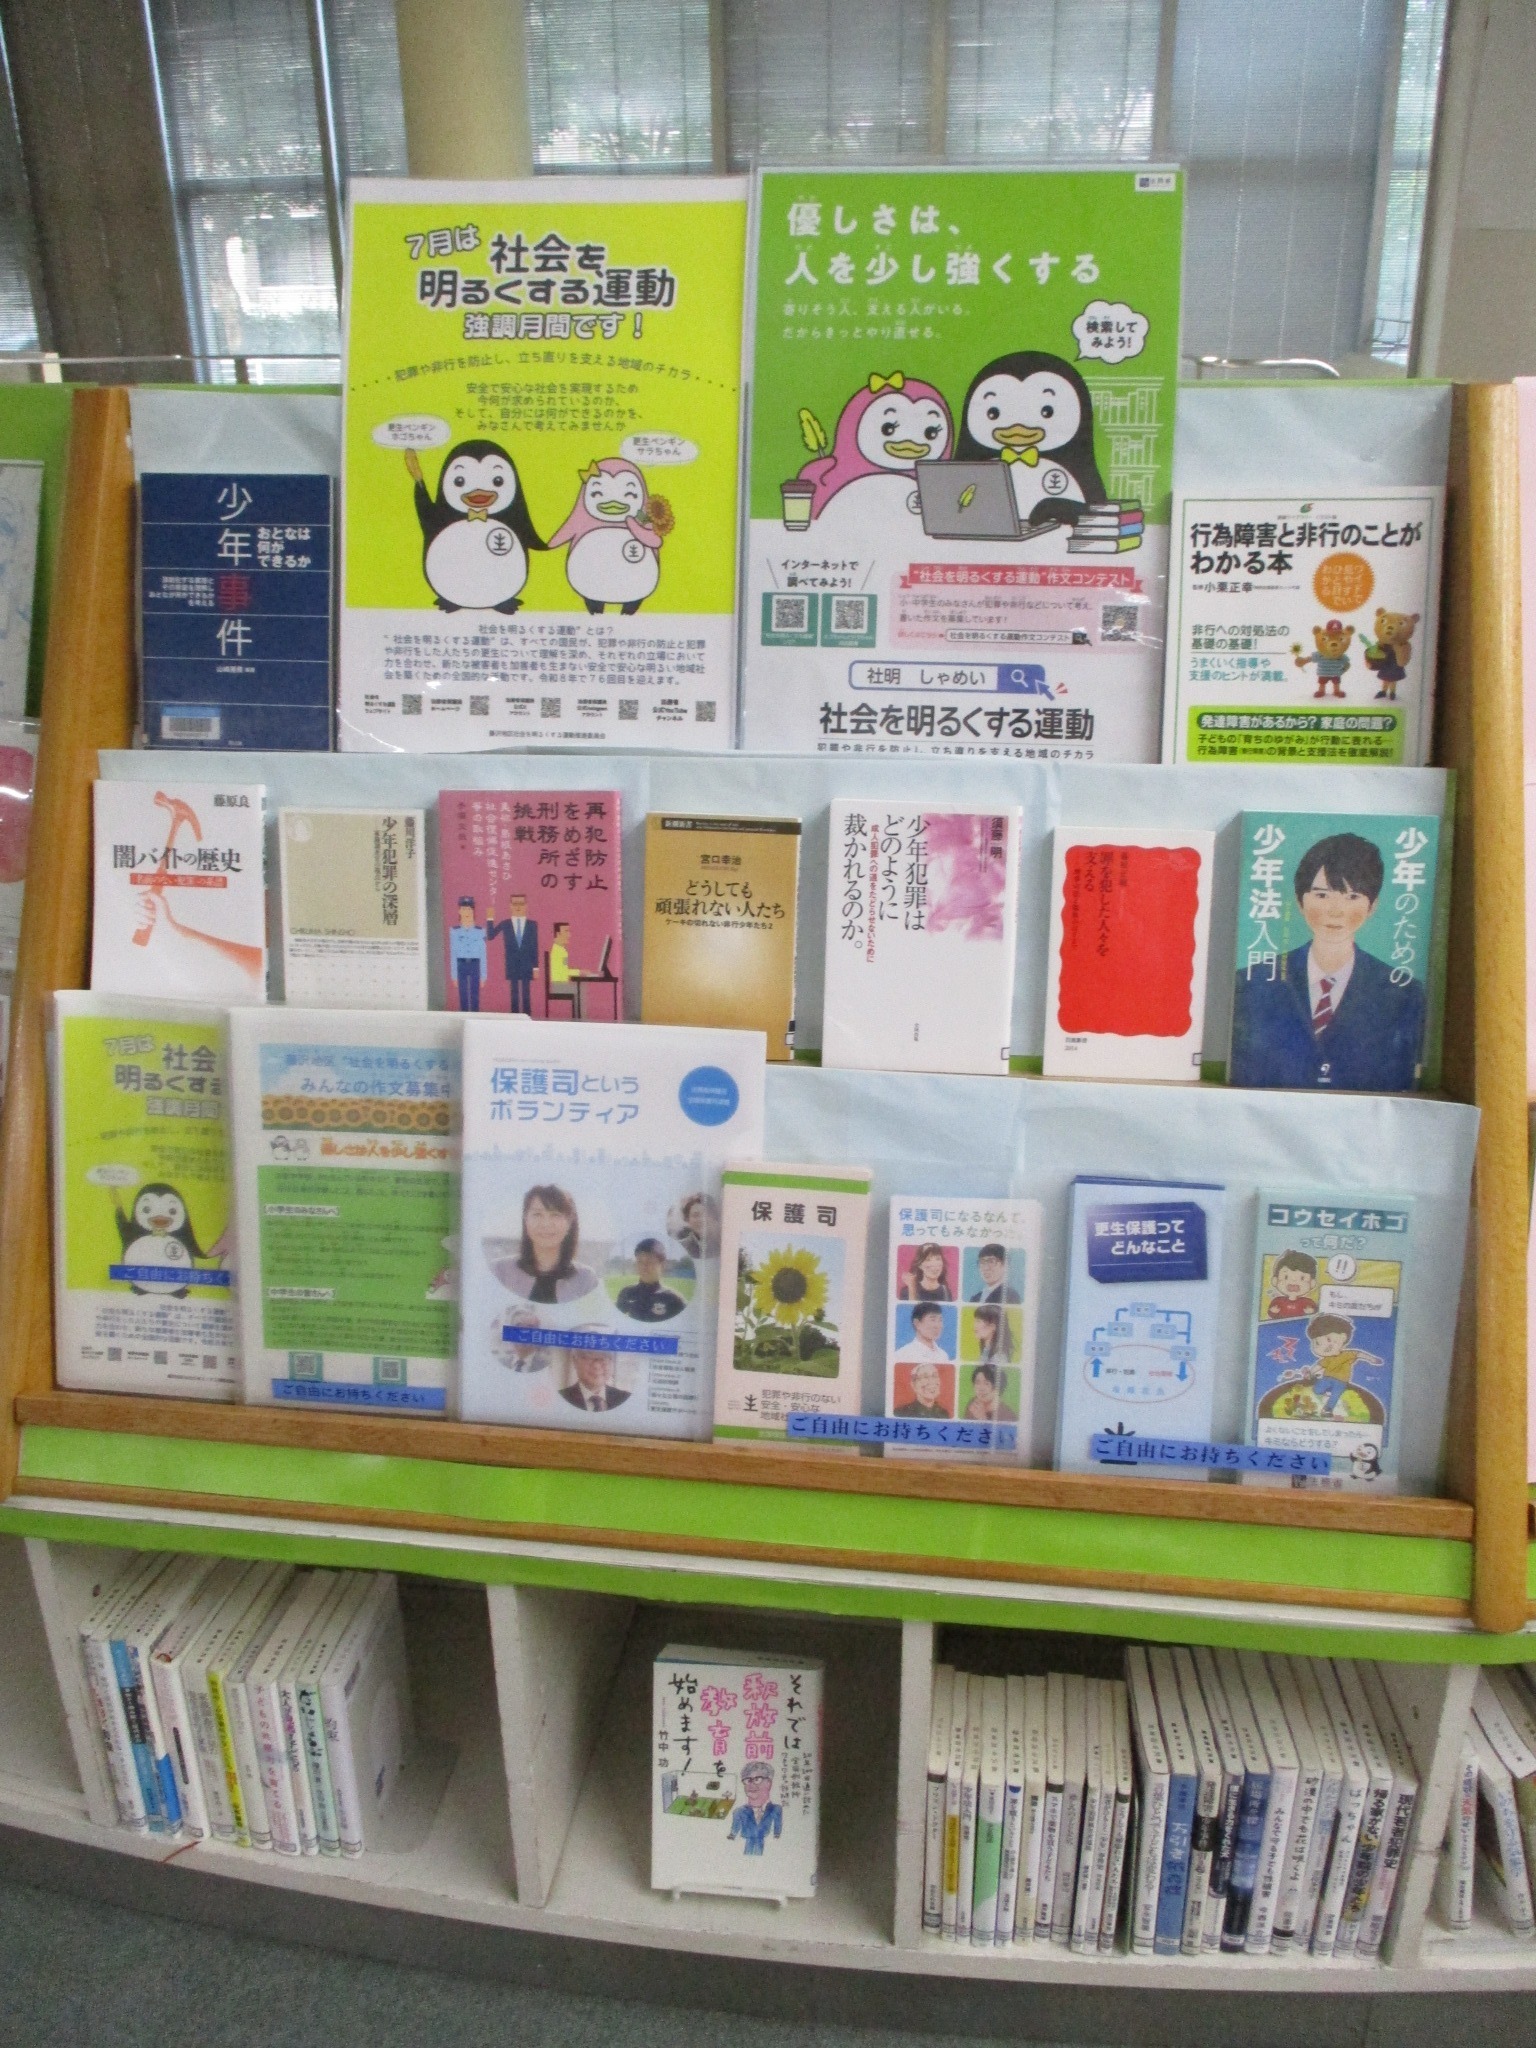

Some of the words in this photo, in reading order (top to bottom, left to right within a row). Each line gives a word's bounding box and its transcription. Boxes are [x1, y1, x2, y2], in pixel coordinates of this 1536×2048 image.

[787, 201, 960, 236] 優しさは、
[405, 224, 480, 260] 7月は
[490, 234, 606, 278] 社会を
[785, 252, 1100, 286] 人を少し強くする
[418, 267, 676, 309] 明るくする運動
[463, 312, 643, 339] 強調月間です！
[1085, 321, 1138, 334] 検索して
[257, 527, 311, 540] おとなは
[257, 540, 285, 554] 何が
[1190, 521, 1423, 548] 行為障害と非行のことが
[257, 555, 311, 568] できるか
[781, 560, 859, 572] インターネットで
[1190, 550, 1293, 575] わかる本
[1191, 624, 1290, 637] 非行への対処法の
[866, 667, 901, 684] 社明
[920, 669, 986, 685] しゃめい
[1190, 657, 1271, 669] うまくいく指導や
[819, 702, 1095, 741] 社会を明るくする運動
[513, 801, 537, 844] 挑戦
[112, 844, 243, 873] 闇バイトの歴史
[536, 801, 560, 889] 刑務所の
[564, 802, 582, 890] をめざす
[584, 801, 608, 891] 再犯防止
[382, 816, 399, 926] 少年犯罪の深層
[700, 854, 742, 866] 宮口幸治
[879, 813, 903, 921] どのように
[904, 815, 931, 931] 少年犯罪は
[685, 879, 753, 899] どうしても
[841, 813, 867, 949] 裁かれるのか。
[655, 897, 785, 919] 頑張れない人たち
[1246, 823, 1286, 982] 少年法入門
[1389, 826, 1429, 988] 少年のための
[162, 1043, 216, 1072] 社会
[490, 1066, 639, 1096] 保護司という
[490, 1099, 639, 1125] ボランティア
[751, 1200, 837, 1227] 保護司
[1271, 1208, 1407, 1232] コウセイホゴ
[1094, 1219, 1186, 1237] 更生保護って
[1110, 1238, 1186, 1255] どんなこと
[517, 1330, 666, 1352] ご自由にお持ちください
[282, 1384, 427, 1404] ご自由にお持ちください
[761, 1389, 842, 1404] 犯罪や非行のない
[791, 1416, 1015, 1447] ご自由にお持ちください
[1094, 1437, 1330, 1472] ご自由にお持ちください
[743, 1672, 779, 1761] 釈放前
[784, 1674, 806, 1750] それでは
[657, 1730, 669, 1752] 竹中
